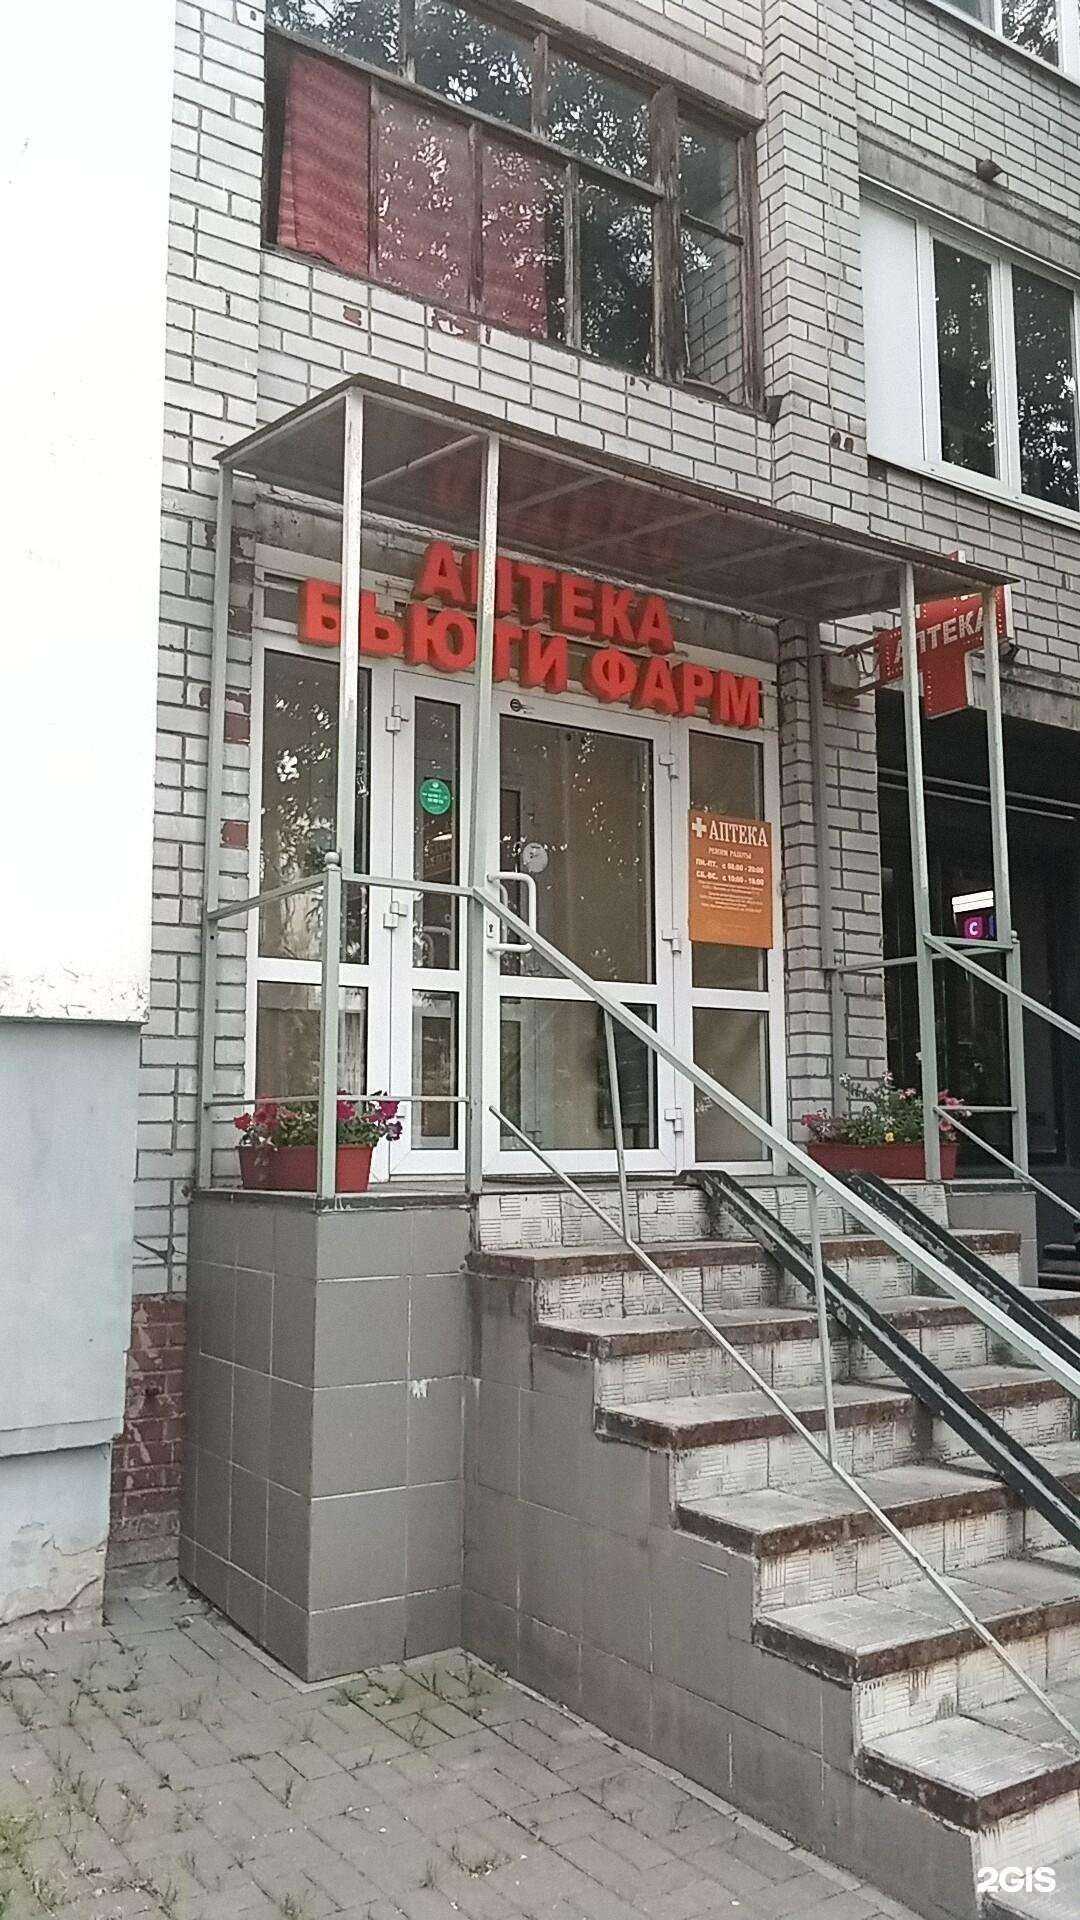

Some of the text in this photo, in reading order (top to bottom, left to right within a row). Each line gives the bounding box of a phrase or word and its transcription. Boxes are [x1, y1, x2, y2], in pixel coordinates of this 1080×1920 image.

[297, 577, 760, 730] БЬЮТИ ФАРМ
[411, 541, 675, 654] АПТЕКА
[709, 820, 768, 847] АПТЕКА
